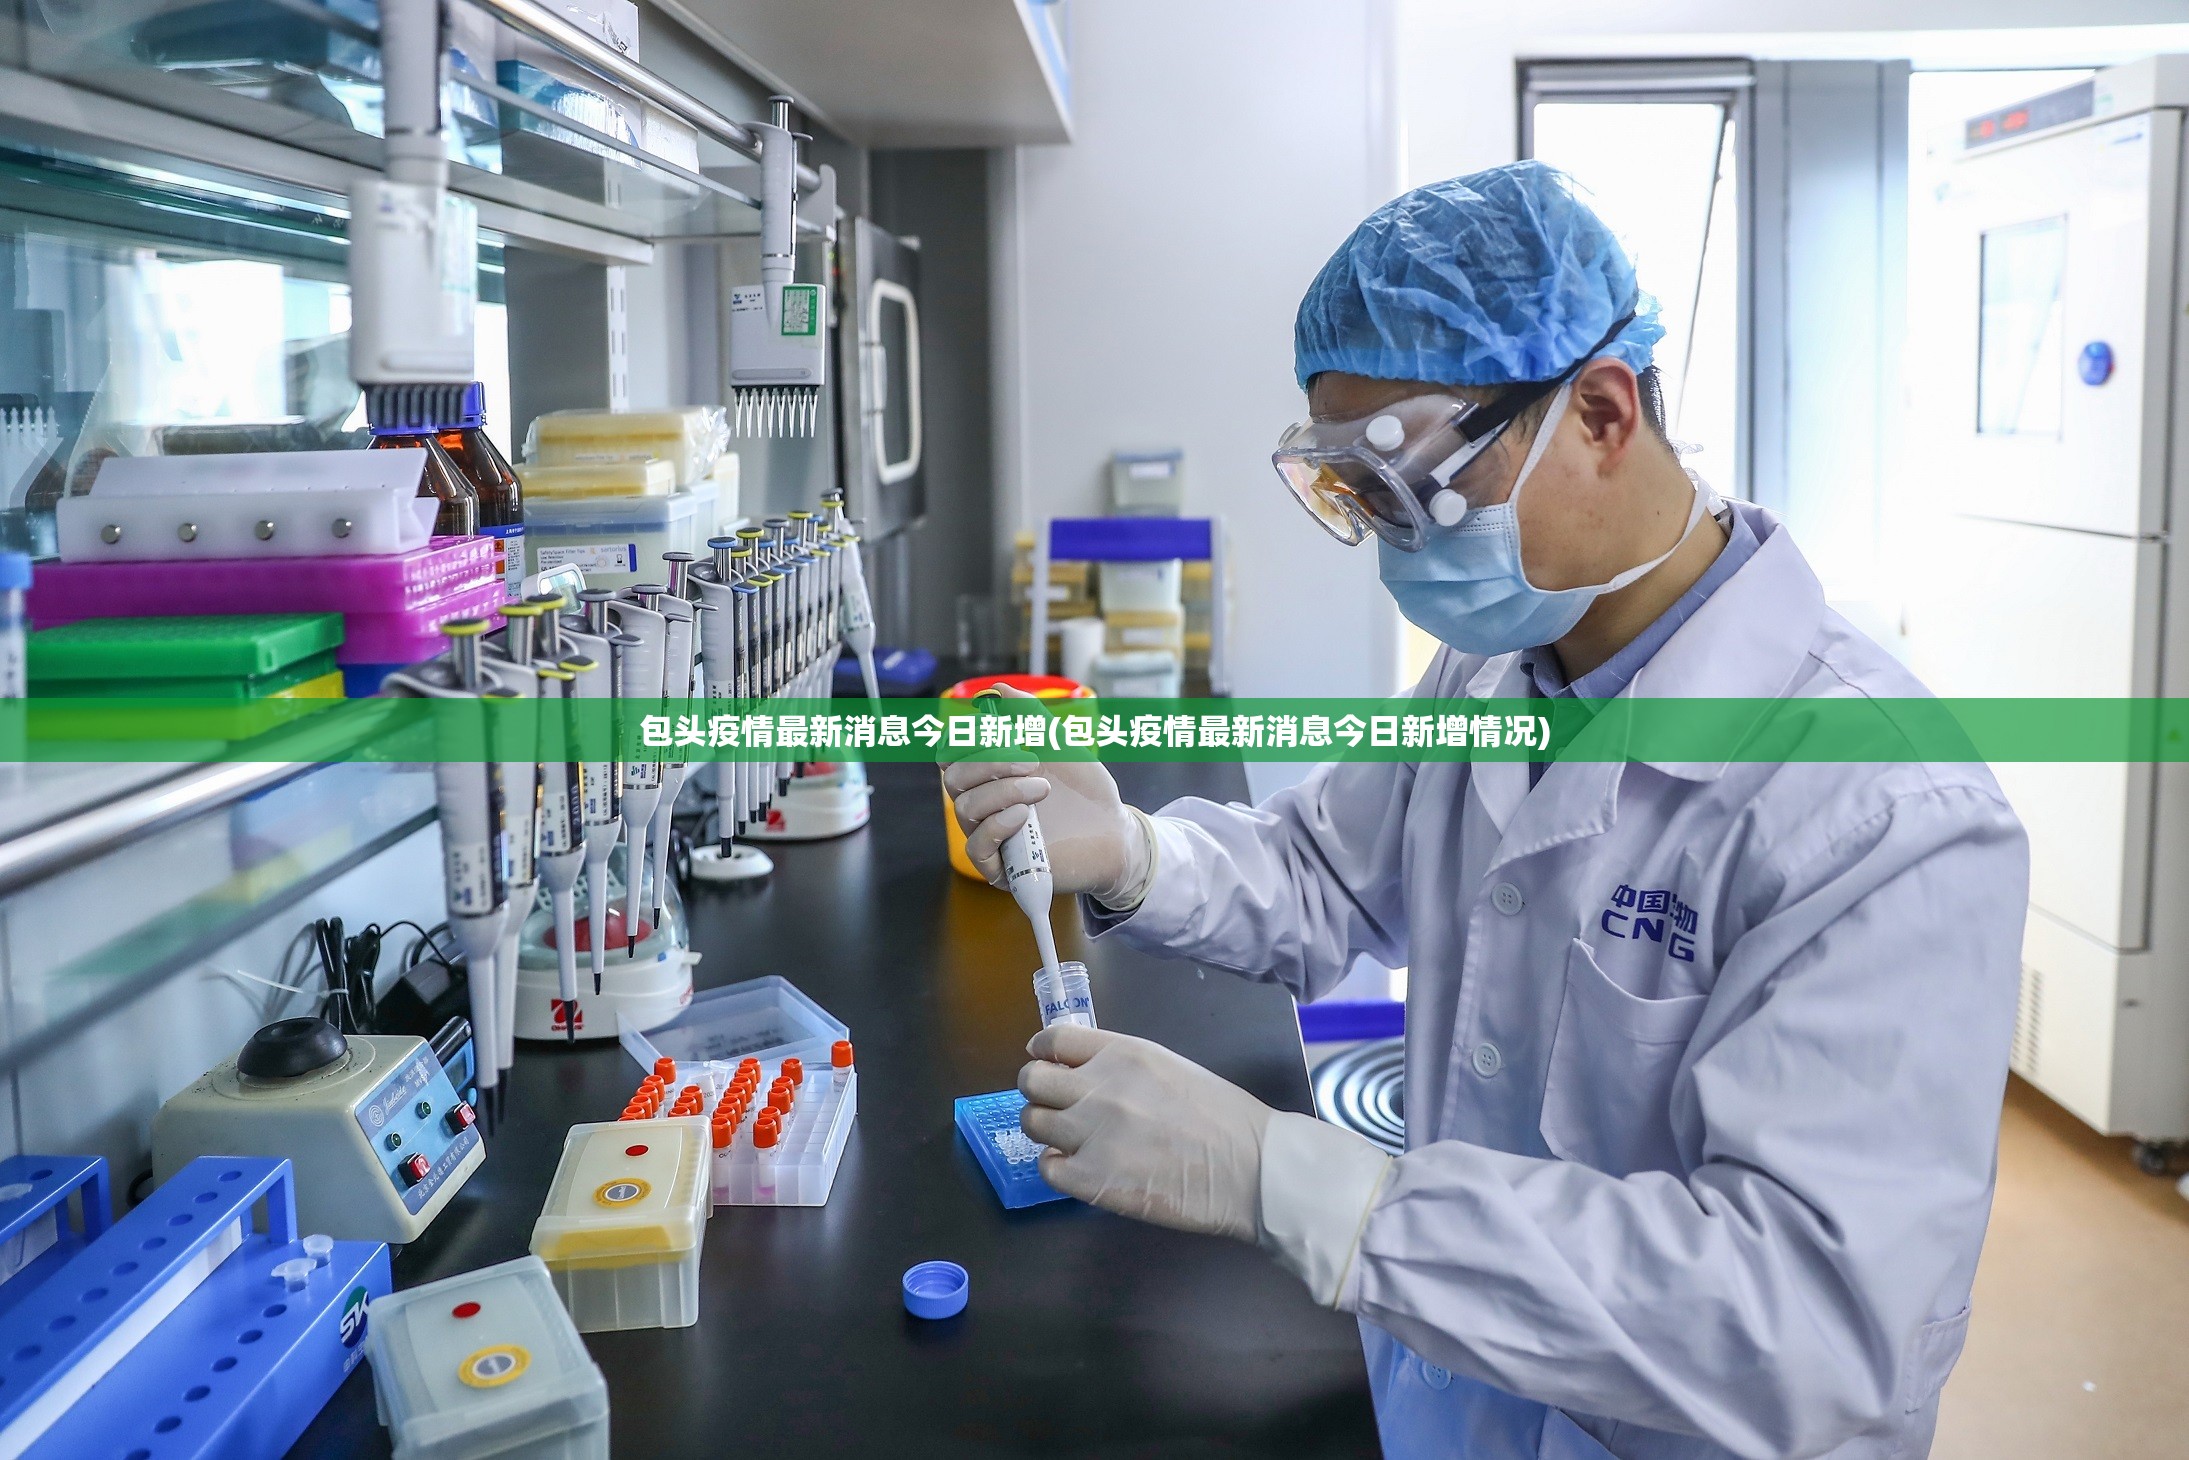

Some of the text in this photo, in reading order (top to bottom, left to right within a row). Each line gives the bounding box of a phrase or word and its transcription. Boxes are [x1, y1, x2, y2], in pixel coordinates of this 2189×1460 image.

[600, 545, 627, 553] sartorius
[1611, 884, 1698, 934] 中国物
[1602, 909, 1695, 962] CNG
